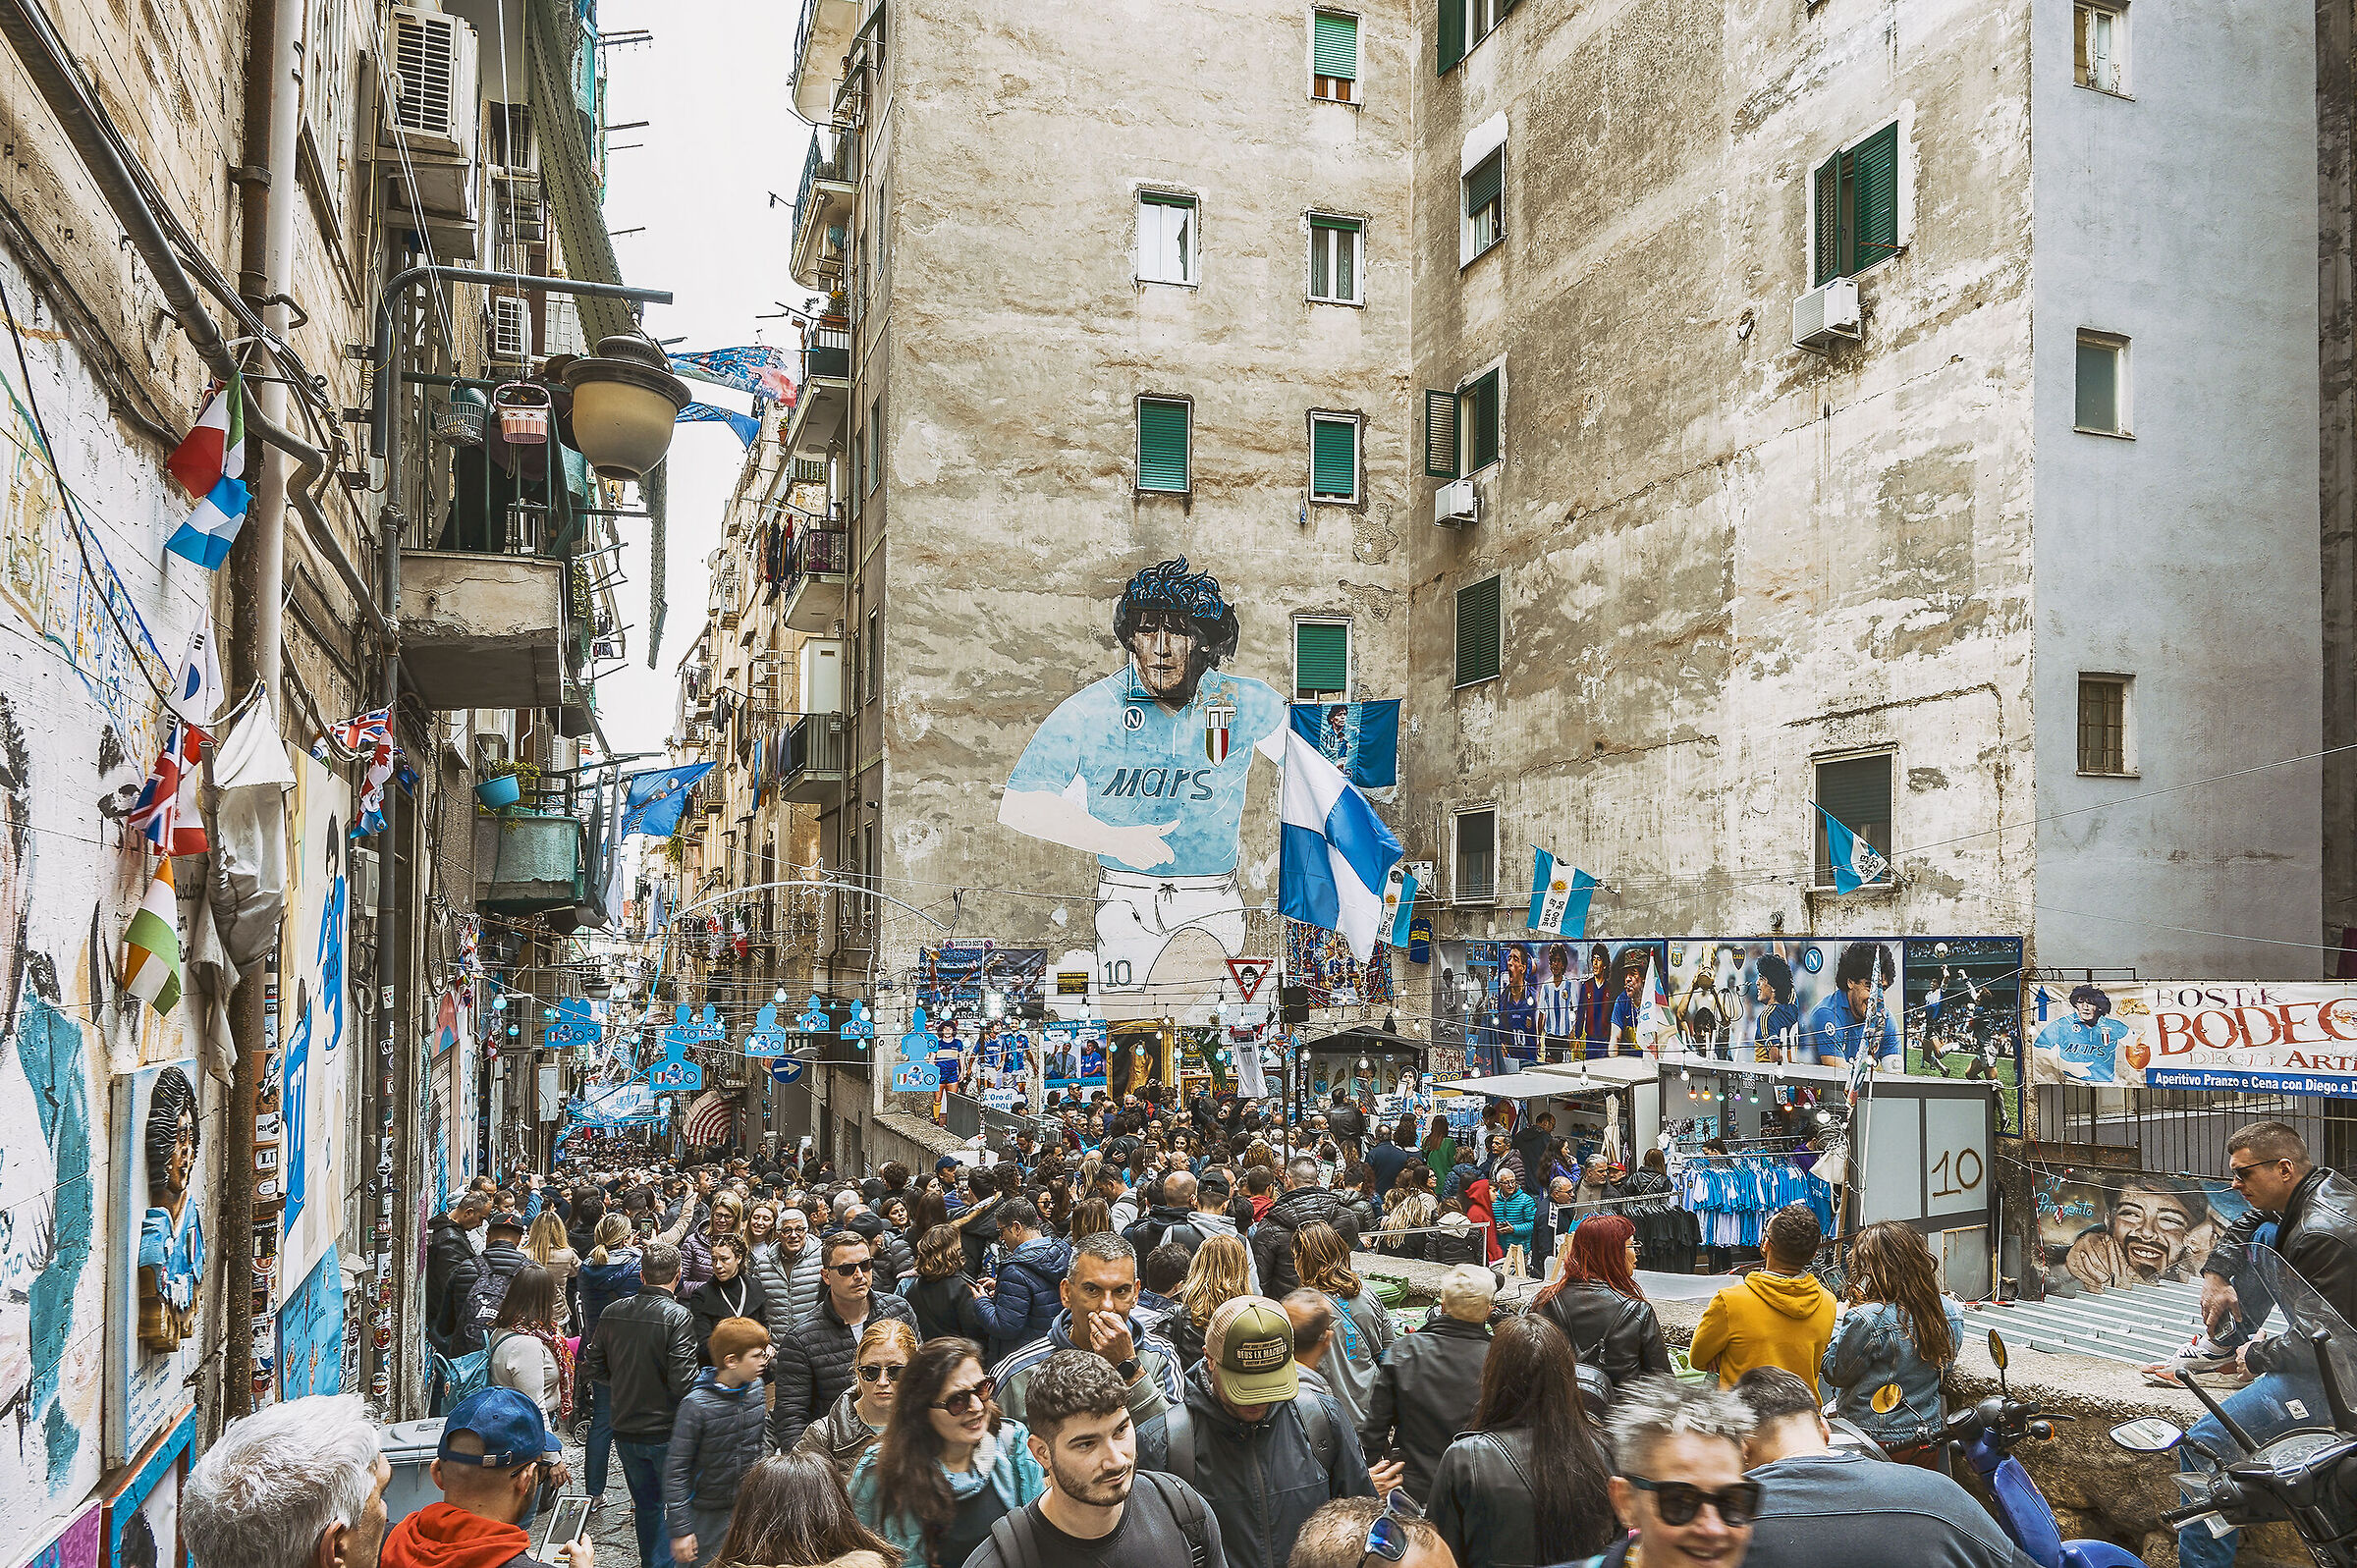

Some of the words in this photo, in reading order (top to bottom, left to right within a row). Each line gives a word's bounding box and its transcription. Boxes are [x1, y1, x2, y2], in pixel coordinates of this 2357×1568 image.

[1124, 709, 1143, 729] N
[1101, 768, 1214, 801] Mars
[1104, 959, 1132, 987] 10
[2065, 1043, 2106, 1056] Mars
[2155, 1072, 2202, 1087] Aperitivo
[2204, 1074, 2240, 1087] Pranzo
[2241, 1077, 2249, 1087] e
[2251, 1076, 2279, 1090] Cena
[2281, 1081, 2303, 1091] con
[2305, 1079, 2338, 1096] Diego
[2340, 1082, 2349, 1093] e
[1931, 1147, 1984, 1198] 10
[2037, 1192, 2095, 1217] Primgenito
[1237, 1350, 1253, 1359] DEUS
[1254, 1350, 1262, 1359] EX
